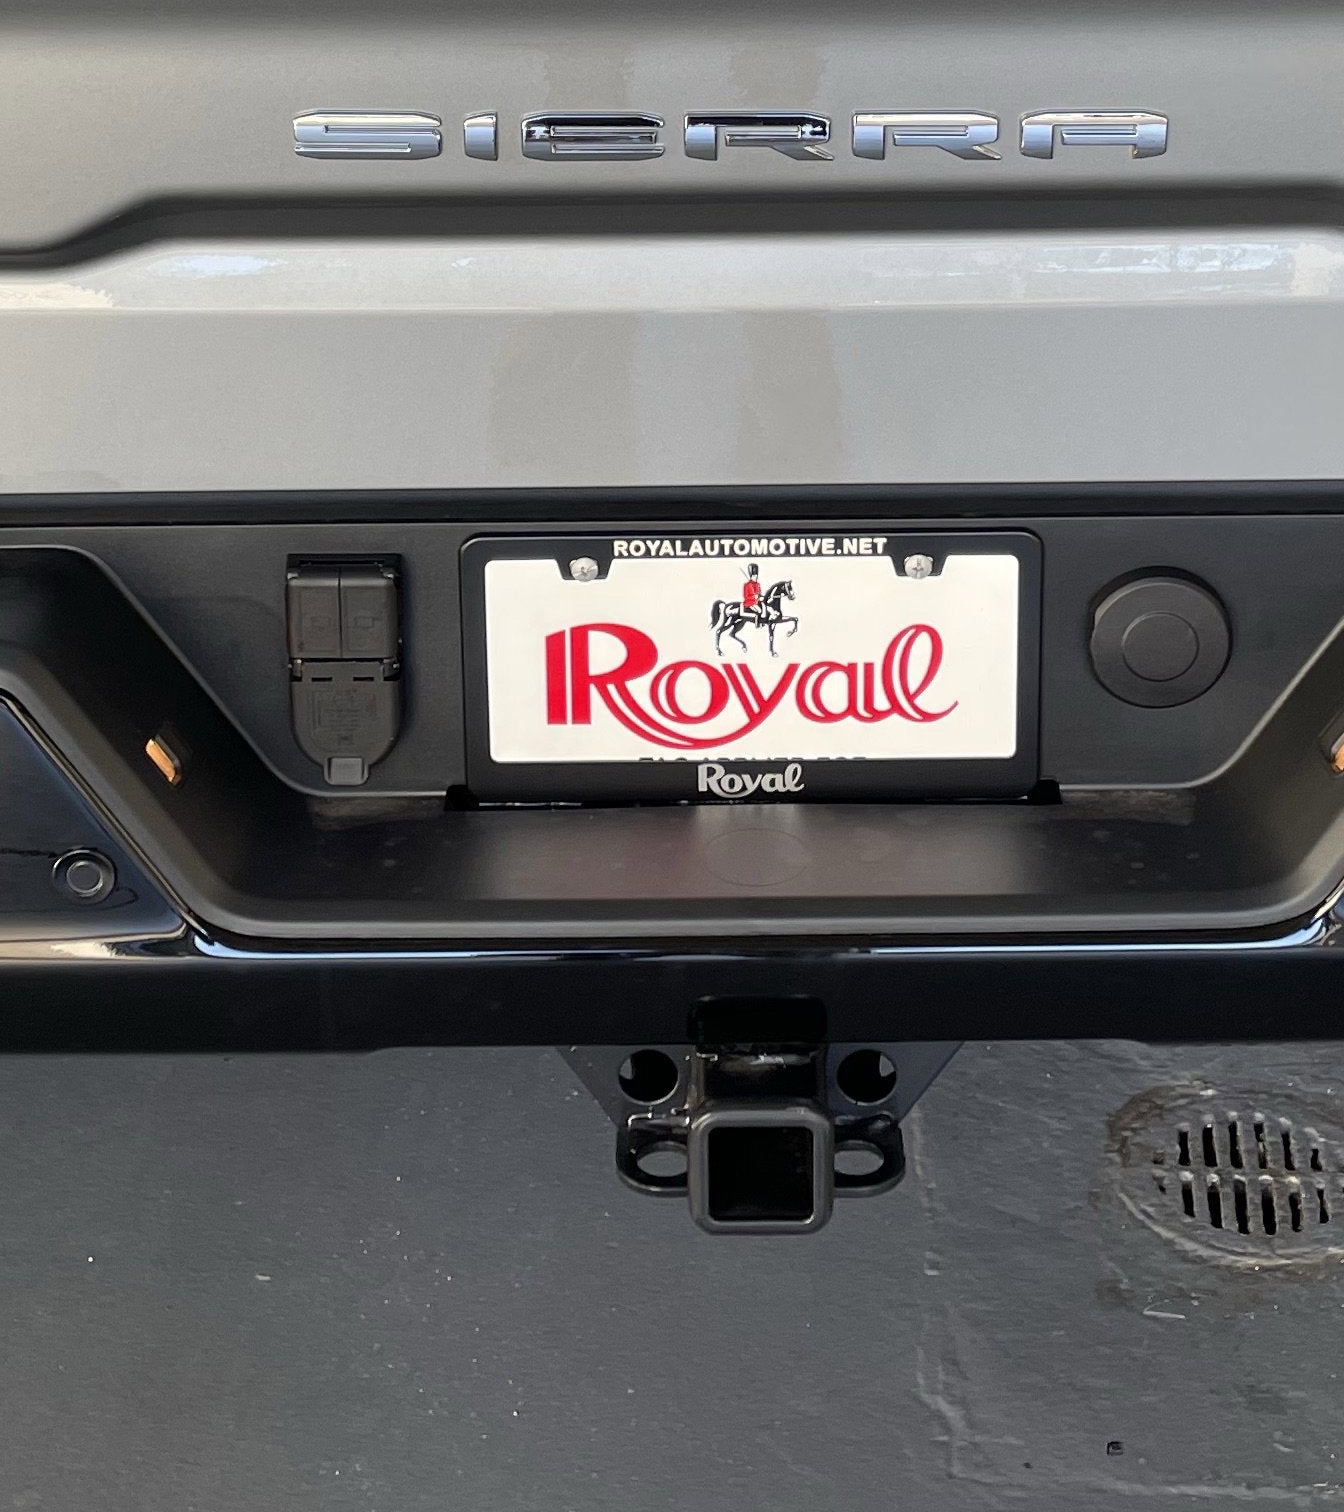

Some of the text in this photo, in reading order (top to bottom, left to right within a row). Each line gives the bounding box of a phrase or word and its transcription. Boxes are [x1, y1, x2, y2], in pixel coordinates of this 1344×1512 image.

[292, 108, 1170, 163] SIERRA
[613, 537, 888, 557] ROYALAUTOMOTIVE.NET
[544, 621, 960, 751] Royal
[697, 762, 806, 800] Royal
